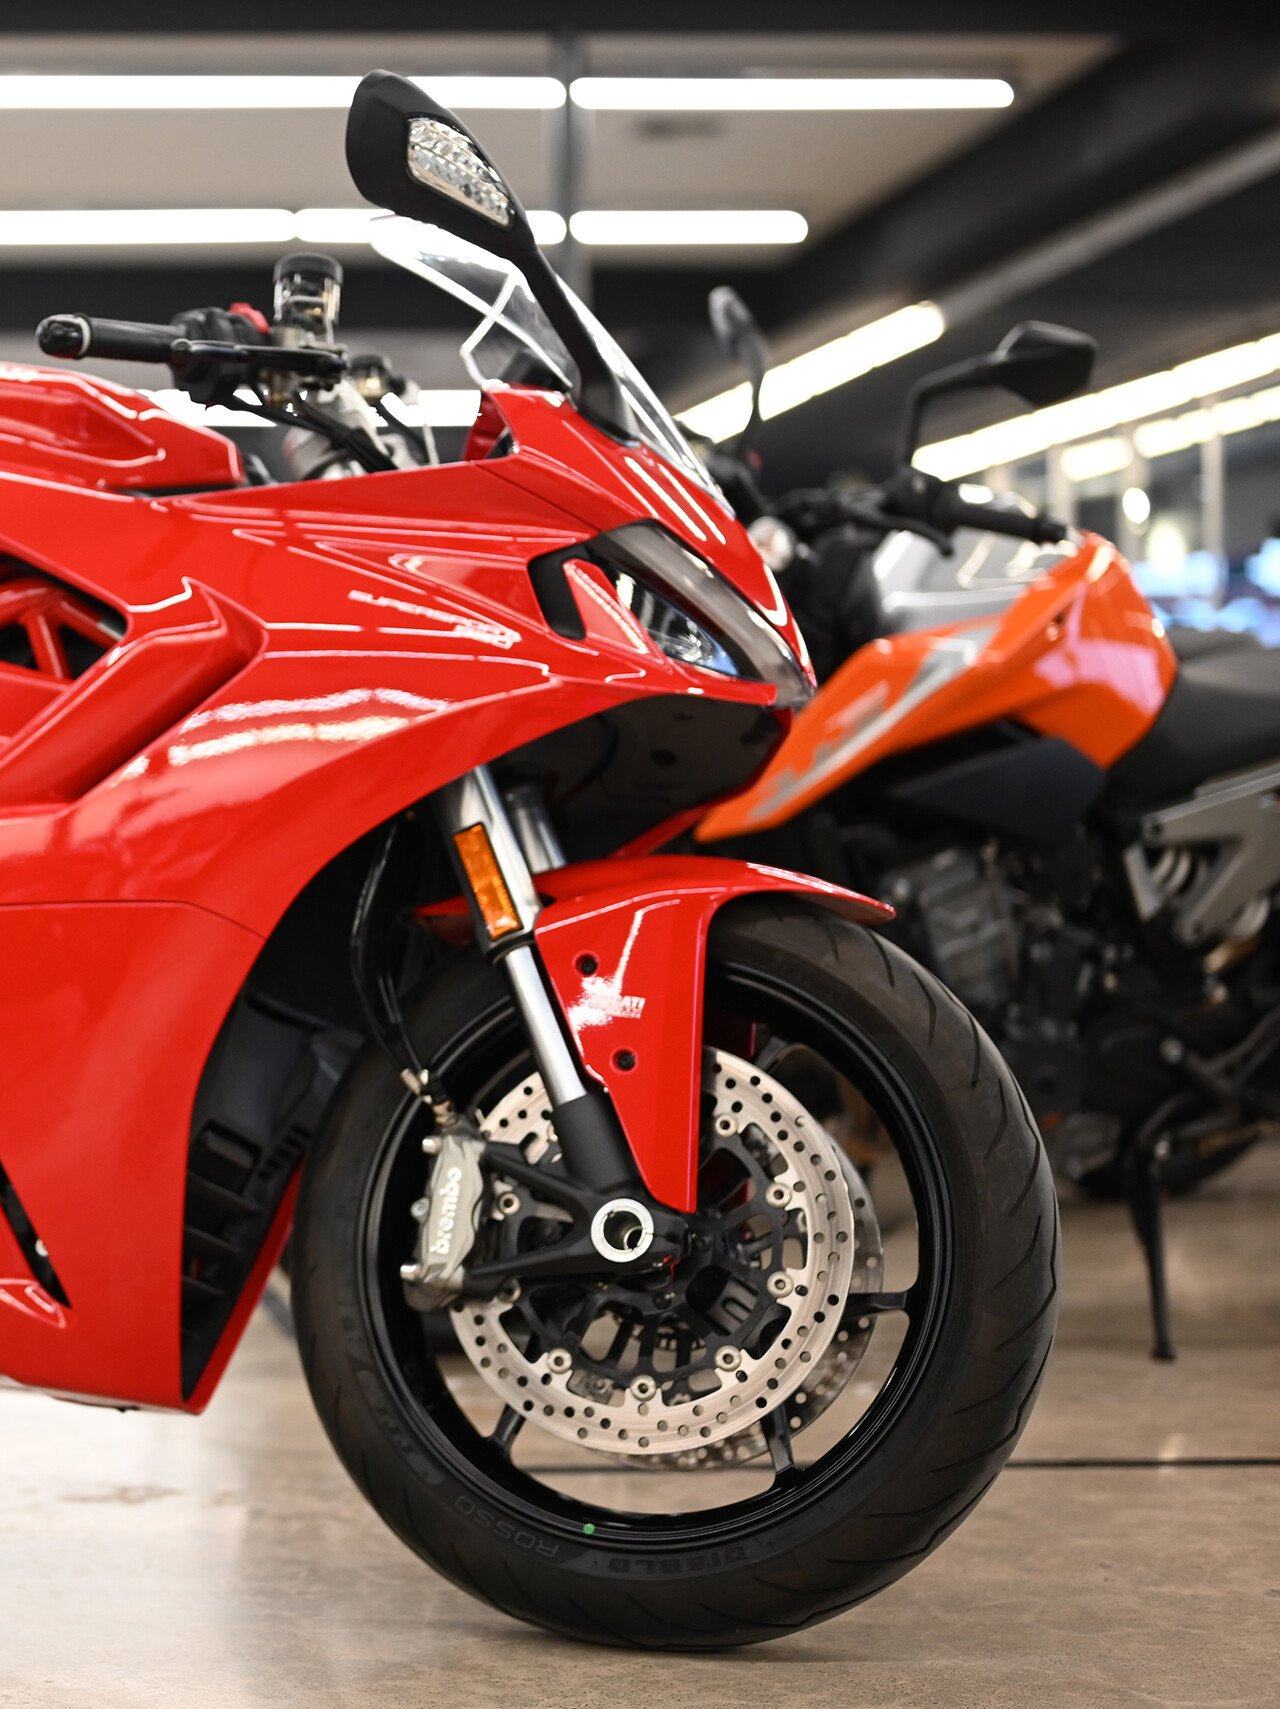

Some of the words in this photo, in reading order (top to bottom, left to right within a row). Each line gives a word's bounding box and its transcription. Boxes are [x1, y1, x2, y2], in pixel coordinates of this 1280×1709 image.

[429, 1167, 462, 1255] brembo
[453, 1495, 561, 1559] ROSSO
[609, 1546, 747, 1575] DIABLO
